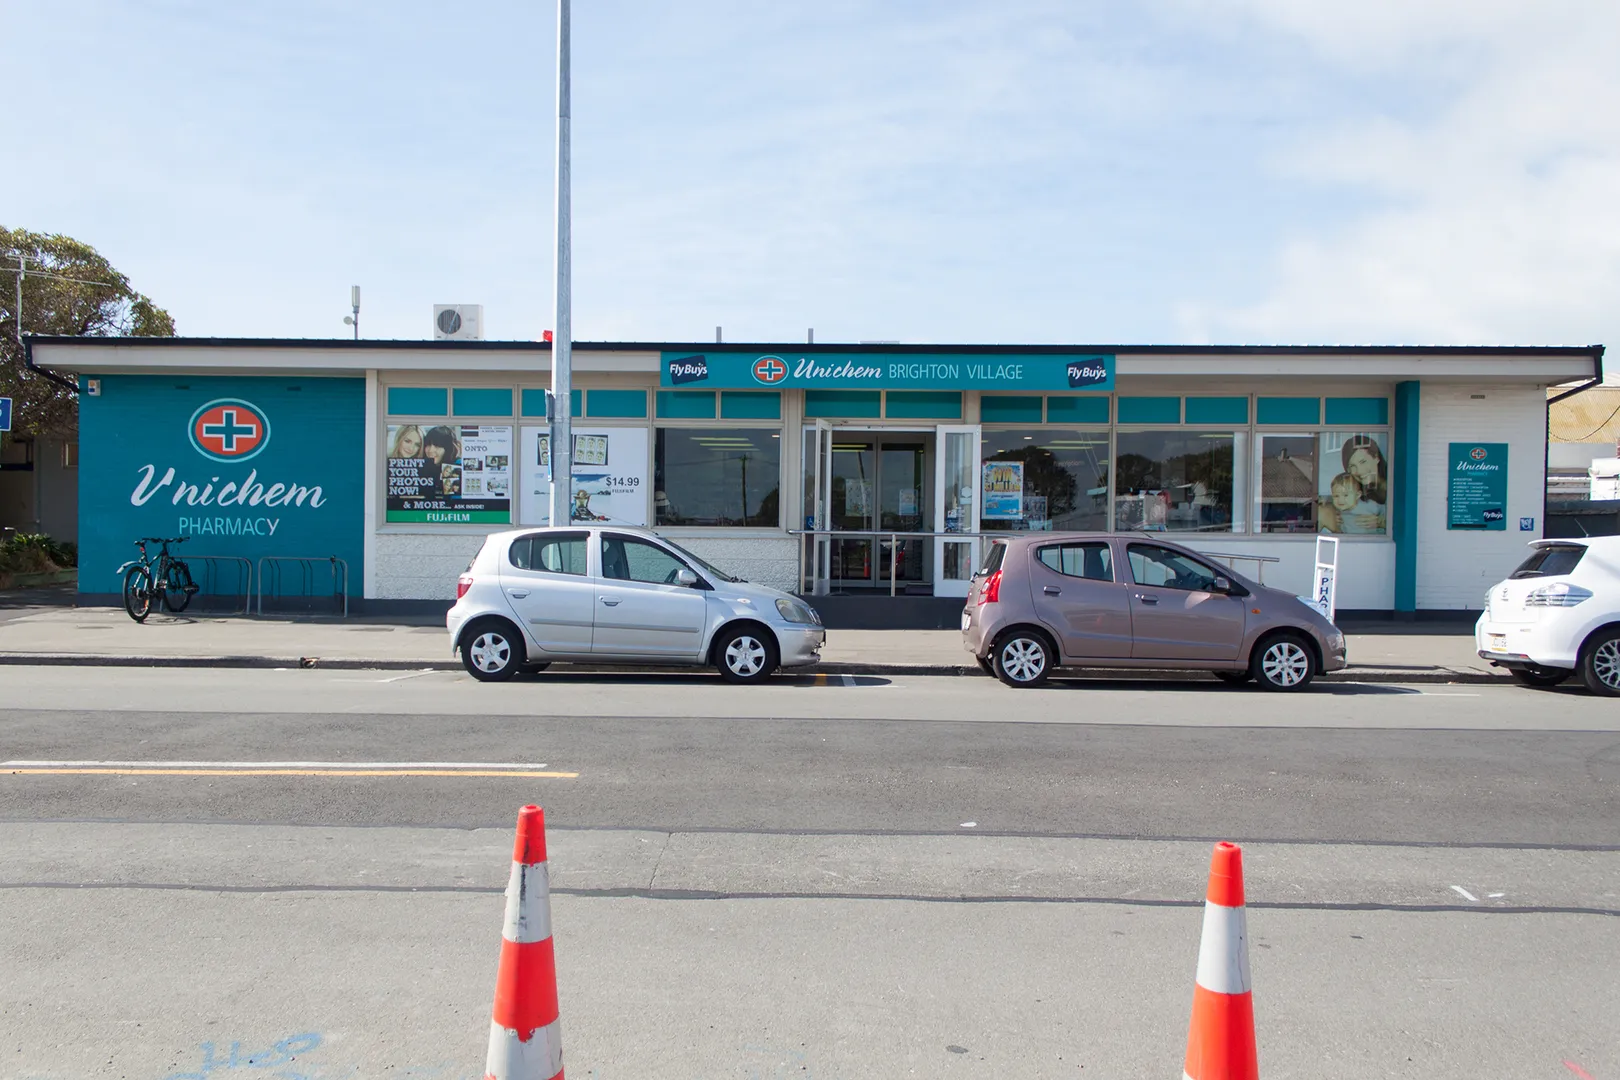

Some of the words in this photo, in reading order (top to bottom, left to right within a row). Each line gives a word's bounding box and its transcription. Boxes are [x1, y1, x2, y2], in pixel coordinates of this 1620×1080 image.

[793, 358, 883, 379] Unichem
[889, 363, 959, 379] BRIGHTON
[966, 364, 1023, 380] VILLAGE
[388, 458, 425, 468] PRINT
[1456, 460, 1499, 471] Unichem
[388, 467, 419, 477] YOUR
[388, 477, 434, 487] PHOTOS
[605, 476, 640, 487] $14.99
[388, 486, 419, 495] NOW!
[403, 501, 411, 509] &
[426, 513, 470, 521] FUJIFILM
[179, 517, 280, 536] PHARMACY
